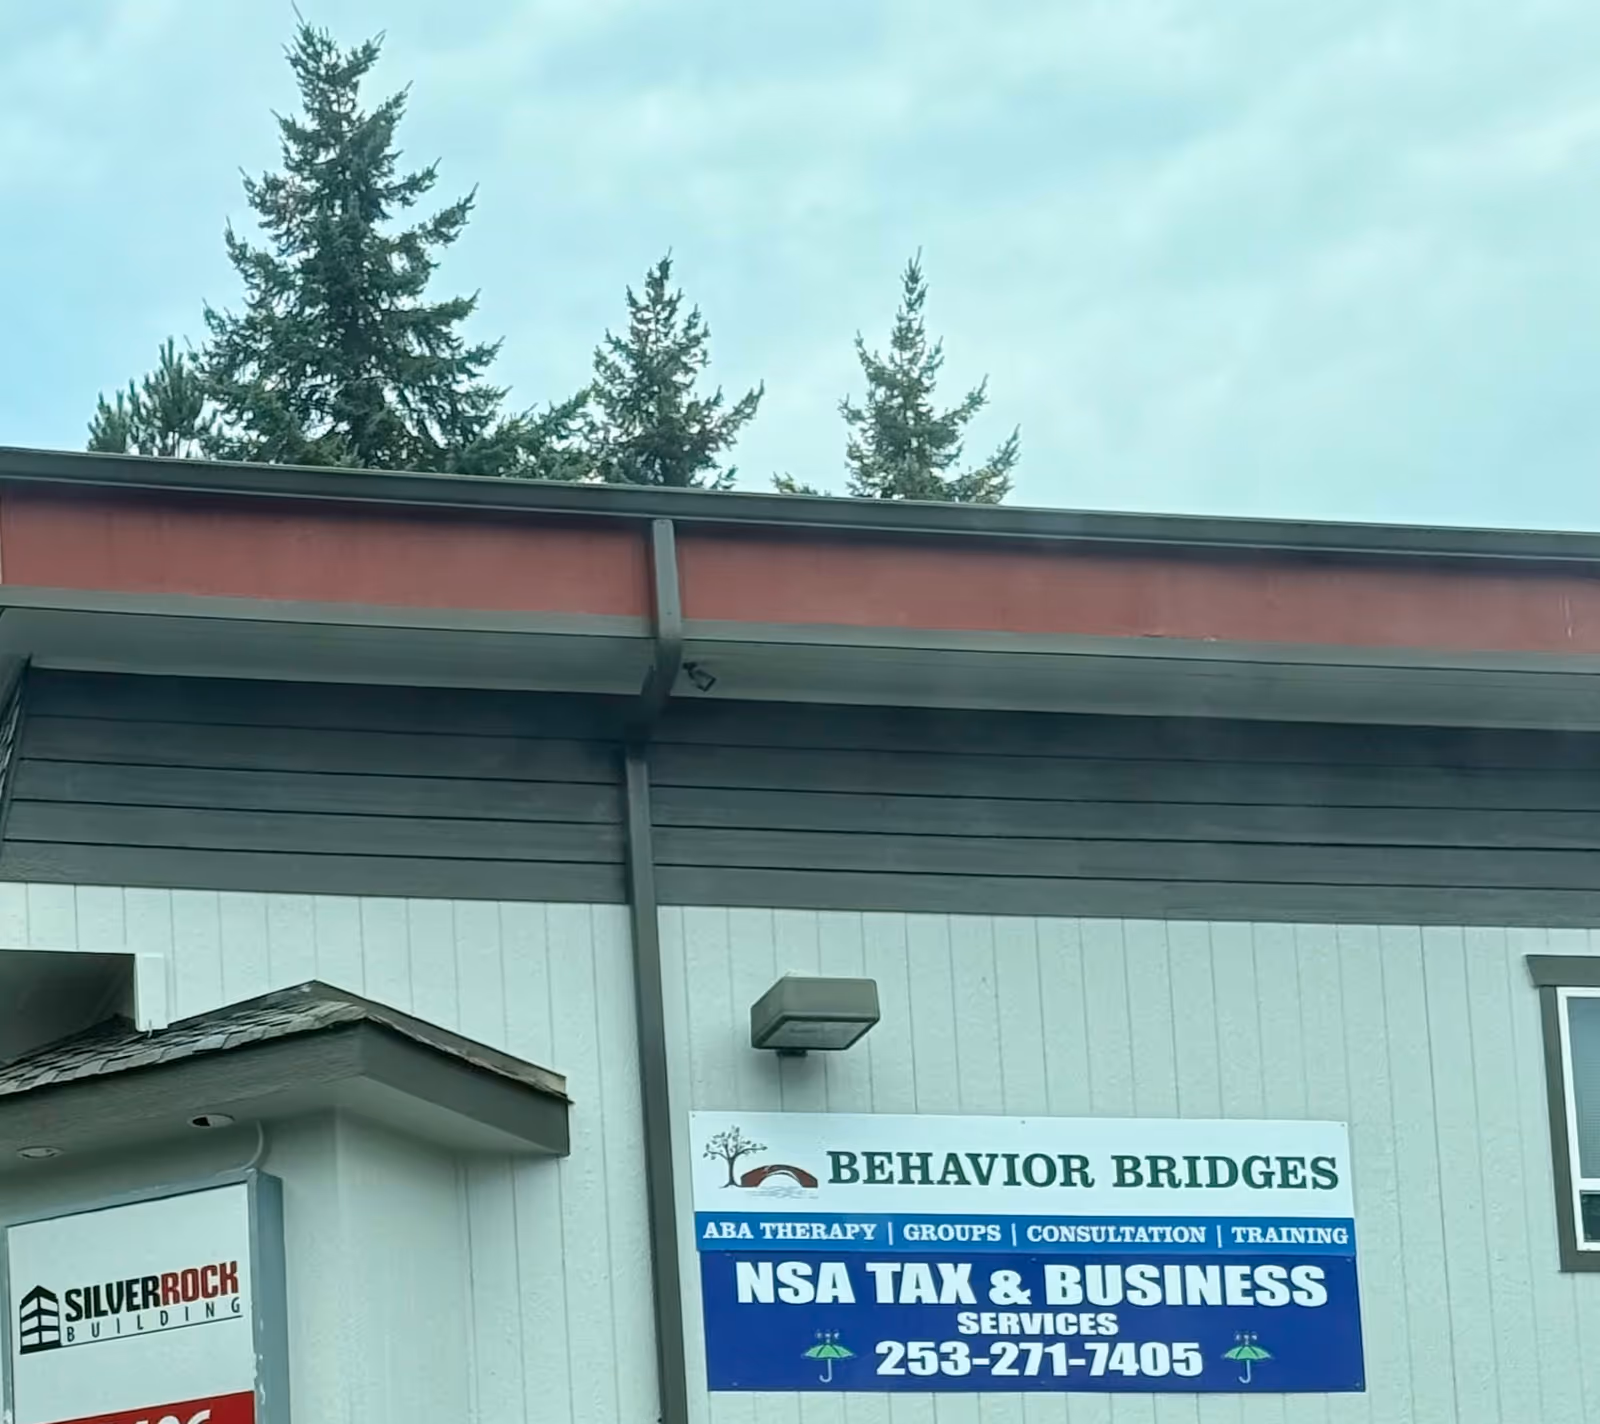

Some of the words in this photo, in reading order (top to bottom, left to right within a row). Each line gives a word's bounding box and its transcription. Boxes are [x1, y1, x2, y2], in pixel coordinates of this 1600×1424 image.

[827, 1150, 1095, 1189] BEHAVIOR
[1111, 1154, 1339, 1190] BRIDGES
[703, 1221, 754, 1239] ABA
[760, 1222, 877, 1241] THERAPY
[903, 1223, 1002, 1242] GROUPS
[1026, 1225, 1206, 1244] CONSULTATION
[1231, 1226, 1349, 1245] TRAINING
[64, 1260, 239, 1323] SILVERROCK
[736, 1261, 855, 1304] NSA
[866, 1262, 977, 1305] TAX
[989, 1269, 1031, 1306] &
[1044, 1263, 1328, 1307] BUSINESS
[66, 1297, 241, 1342] BUILDING
[957, 1311, 1119, 1336] SERVICES
[875, 1340, 1203, 1377] 253-271-7405
